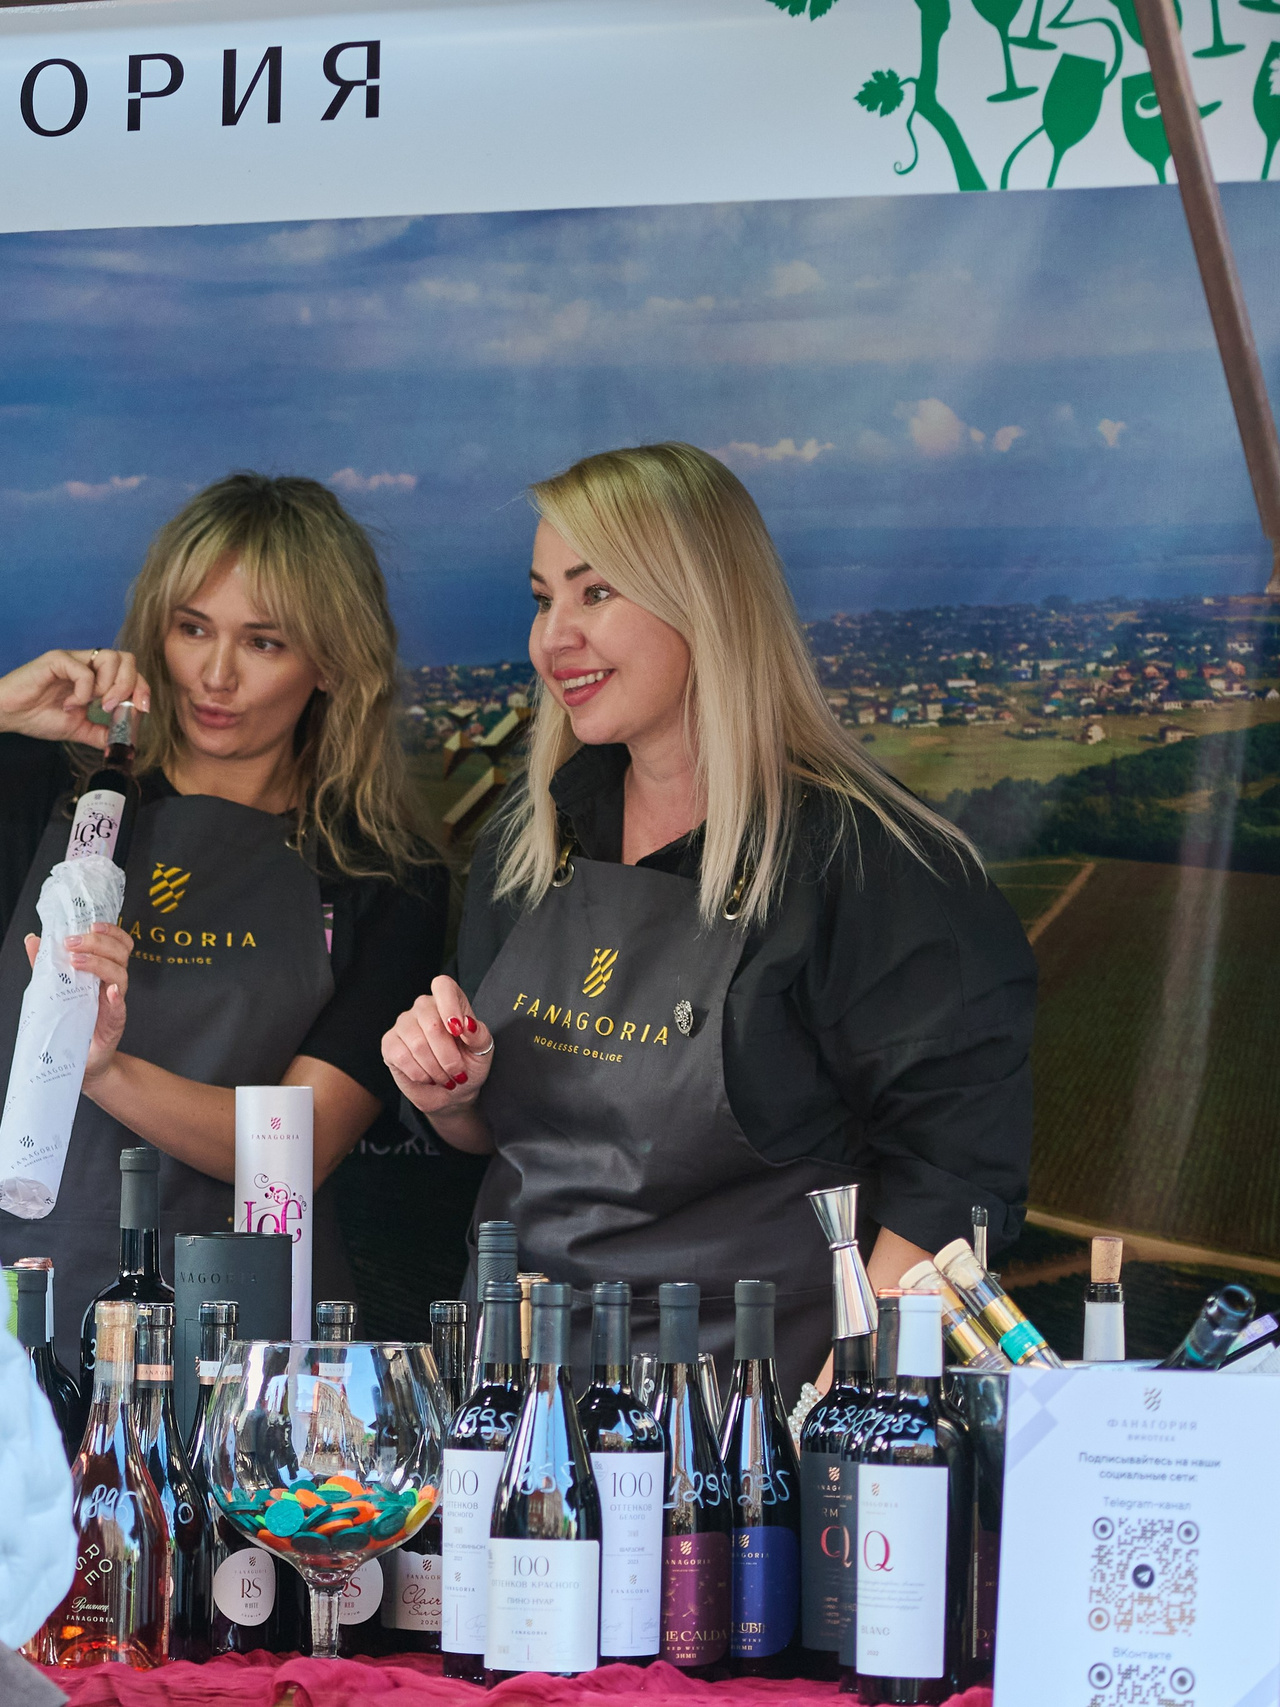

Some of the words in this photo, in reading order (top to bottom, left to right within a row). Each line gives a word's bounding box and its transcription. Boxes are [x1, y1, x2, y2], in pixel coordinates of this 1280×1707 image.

[116, 916, 257, 948] AGORIA
[513, 993, 668, 1046] FANAGORIA
[533, 1035, 580, 1055] NOBLESSE
[583, 1048, 624, 1064] OBLIGE
[1106, 1418, 1198, 1431] ФАНАГОРИЯ
[1078, 1451, 1173, 1467] Подписывайтесь
[1175, 1459, 1189, 1467] на
[1191, 1459, 1221, 1468] наши
[446, 1468, 479, 1496] 100
[611, 1471, 653, 1498] 100
[1099, 1470, 1167, 1481] социальные
[1169, 1473, 1198, 1483] сети:
[1104, 1496, 1192, 1511] Telegram-канал
[863, 1530, 894, 1572] Q
[512, 1555, 550, 1577] 100
[240, 1578, 263, 1599] RS
[401, 1583, 442, 1606] Clair
[66, 1614, 114, 1623] FANAGORIA
[1112, 1646, 1173, 1661] ВКонтакте
